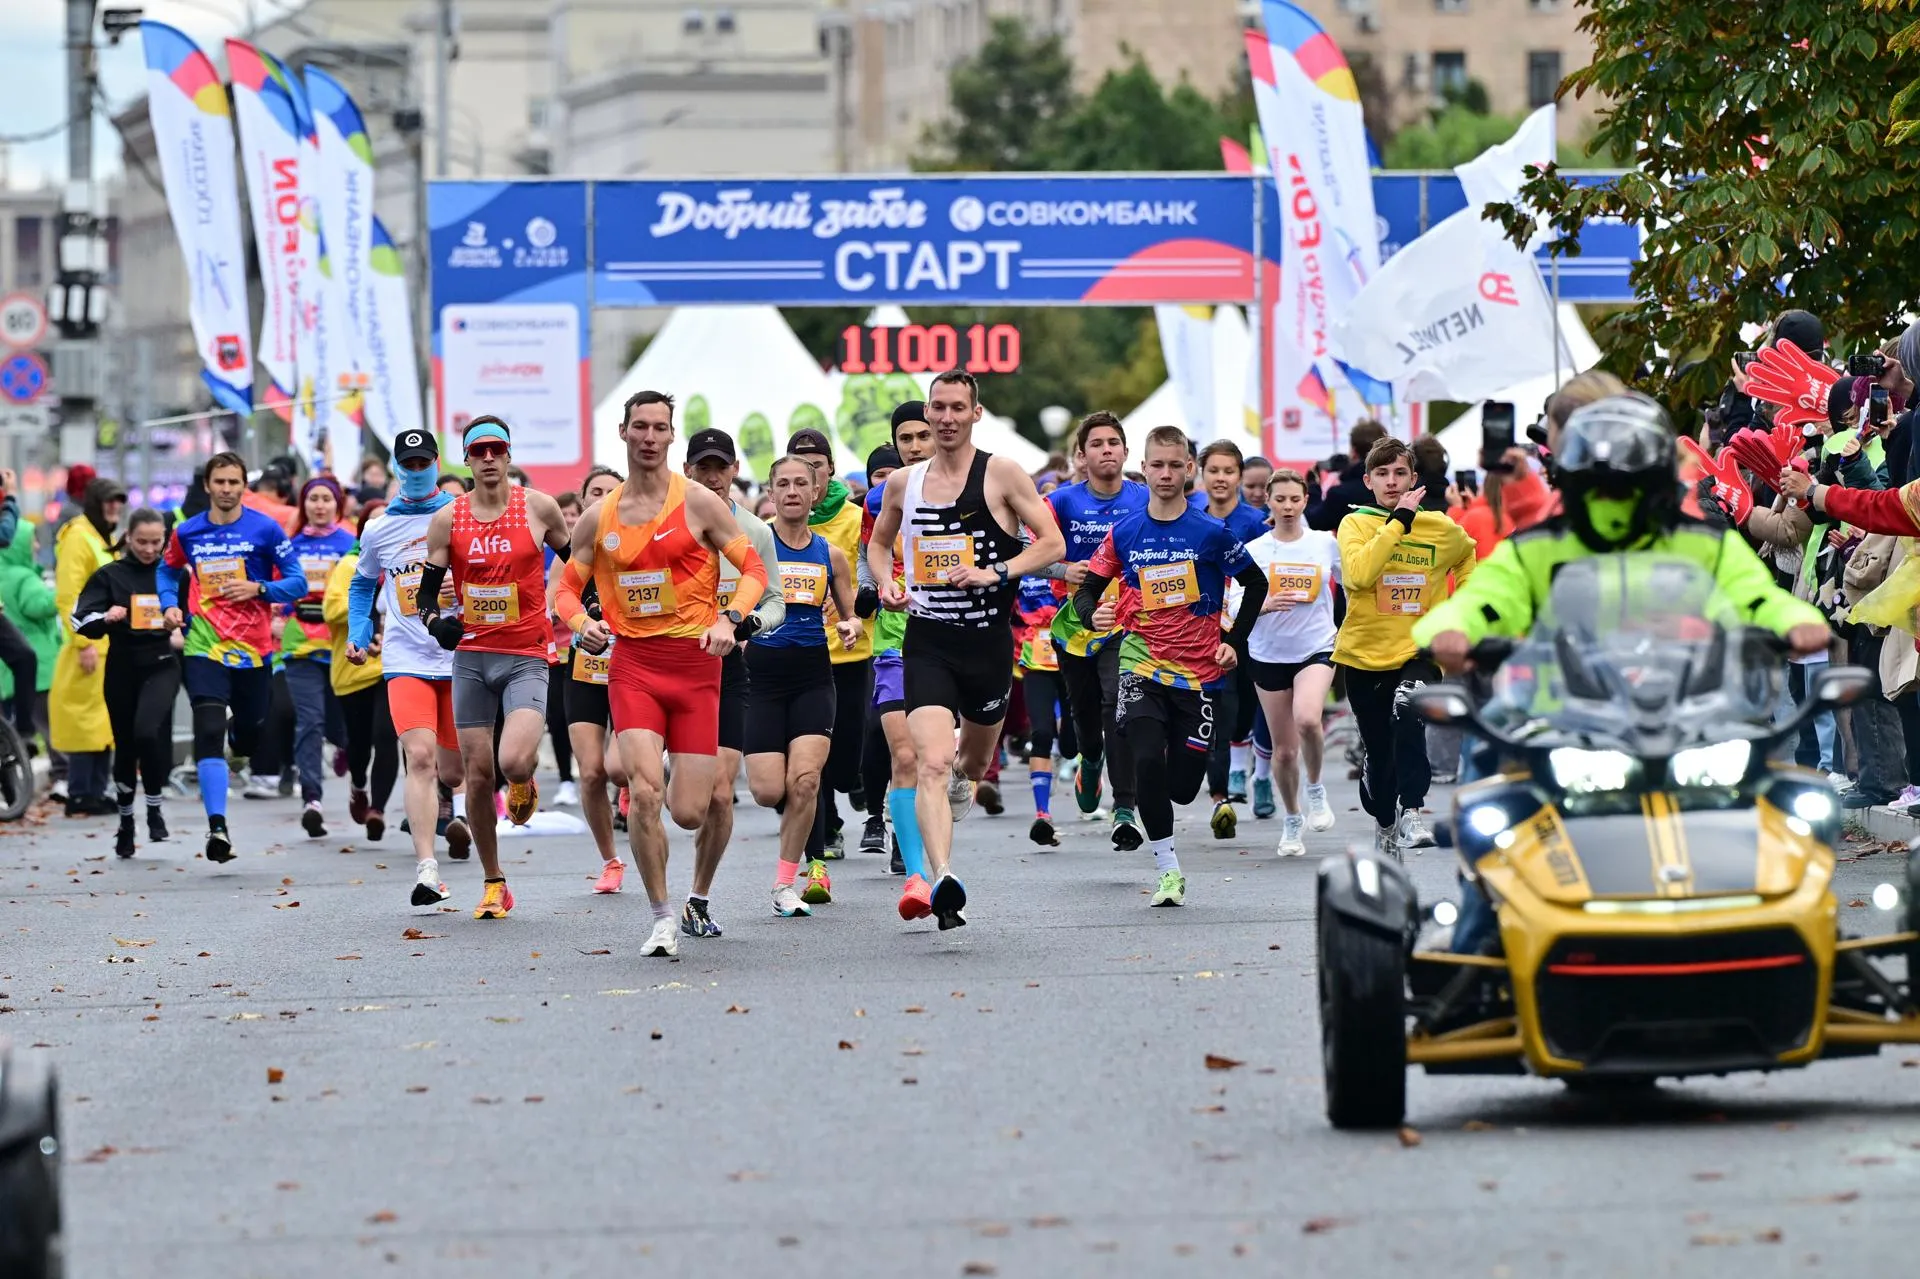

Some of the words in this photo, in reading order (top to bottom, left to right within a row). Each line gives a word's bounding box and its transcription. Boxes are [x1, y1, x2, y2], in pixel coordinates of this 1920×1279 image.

[650, 188, 812, 239] Добрый
[812, 187, 927, 238] забег
[987, 200, 1198, 226] СОВКОМБАНК
[835, 240, 1021, 291] СТАРТ
[841, 324, 894, 373] 11
[898, 324, 958, 373] 00
[965, 324, 1020, 373] 10
[468, 534, 512, 555] Alfa
[924, 554, 960, 568] 2139
[1129, 548, 1168, 562] Добрый
[1168, 548, 1199, 562] забег
[1406, 553, 1429, 566] ДОБРА
[784, 577, 816, 591] 2512
[1151, 578, 1186, 595] 2059
[1279, 577, 1312, 589] 2509
[627, 587, 660, 602] 2137
[1391, 588, 1421, 600] 2177
[472, 600, 508, 612] 2200
